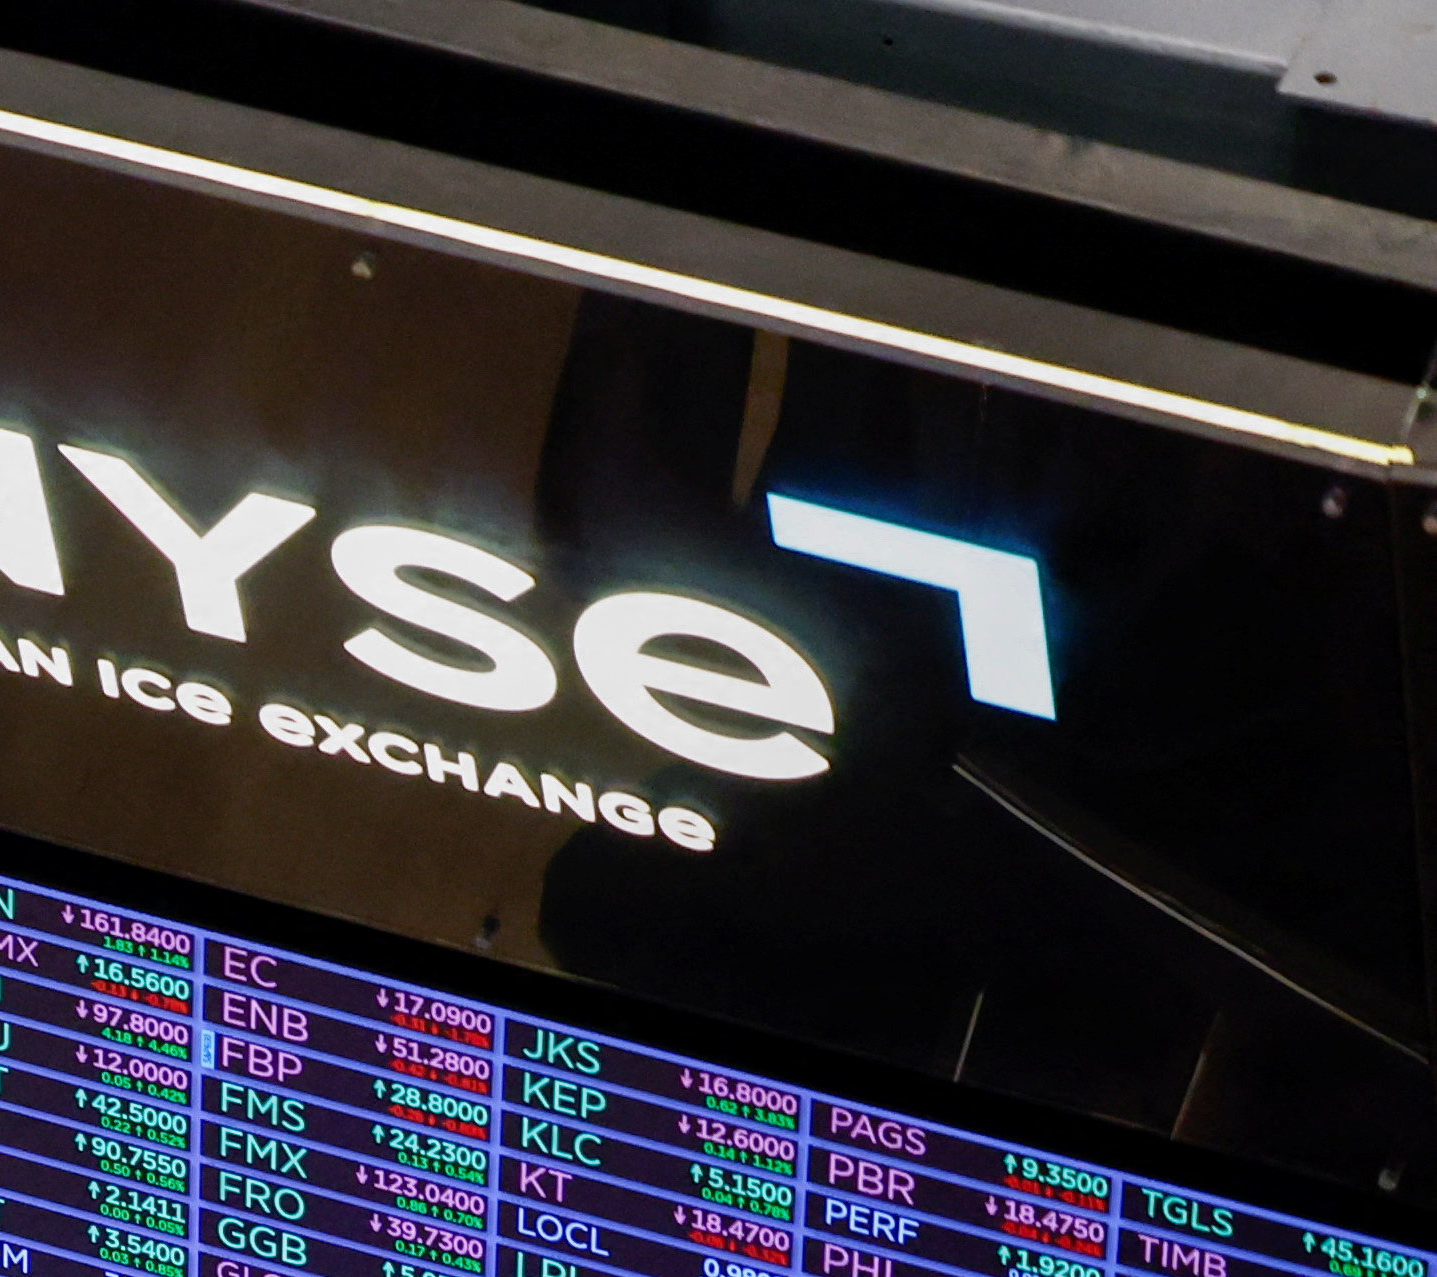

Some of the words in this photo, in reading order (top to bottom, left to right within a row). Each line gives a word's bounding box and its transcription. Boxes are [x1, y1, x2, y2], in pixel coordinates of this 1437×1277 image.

[223, 946, 277, 988] EC
[394, 992, 491, 1034] 17.0900
[220, 1082, 305, 1132] FMS
[389, 1129, 486, 1170] 24.2300
[1141, 1187, 1233, 1237] TGLS
